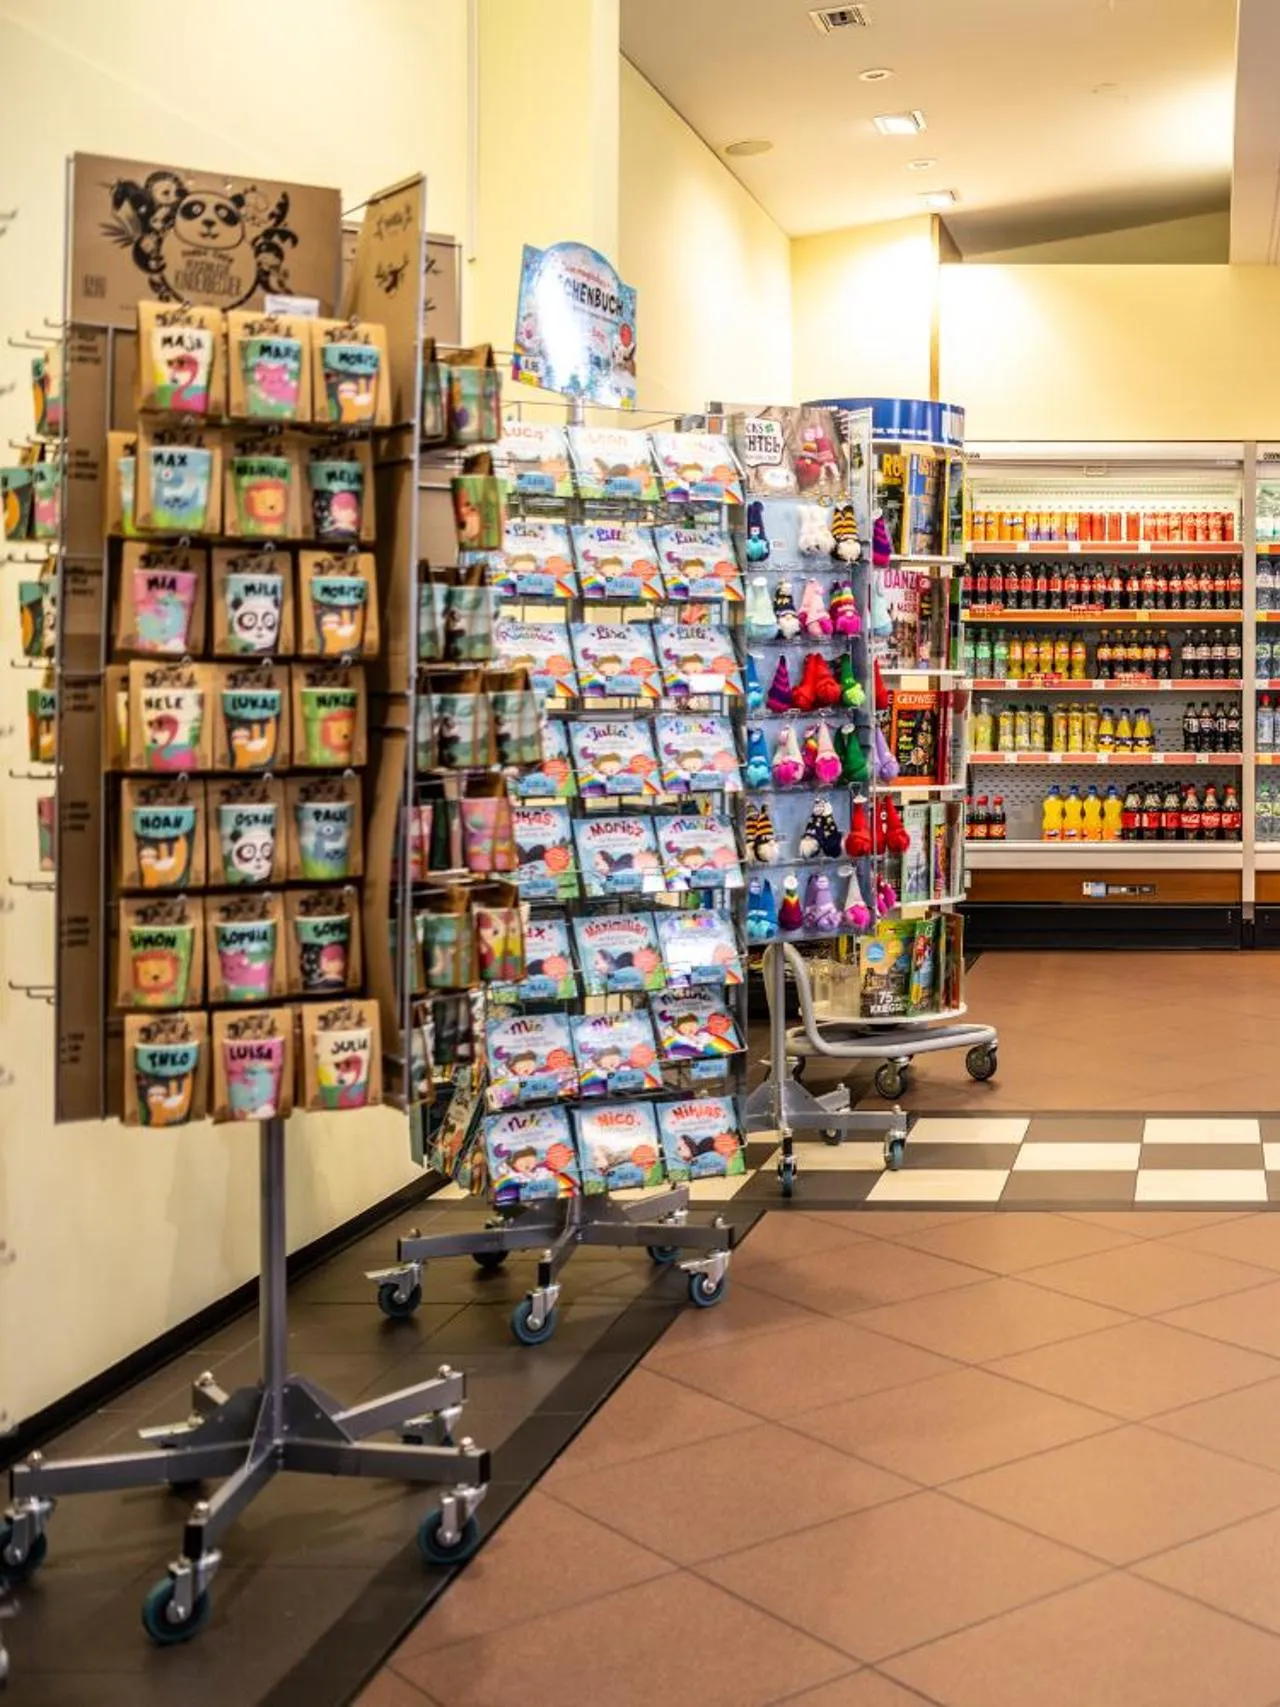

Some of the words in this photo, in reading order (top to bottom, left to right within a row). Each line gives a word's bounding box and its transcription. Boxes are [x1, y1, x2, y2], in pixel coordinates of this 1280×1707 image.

[153, 453, 188, 467] MAX
[147, 577, 177, 592] MIA
[243, 582, 280, 598] MILA
